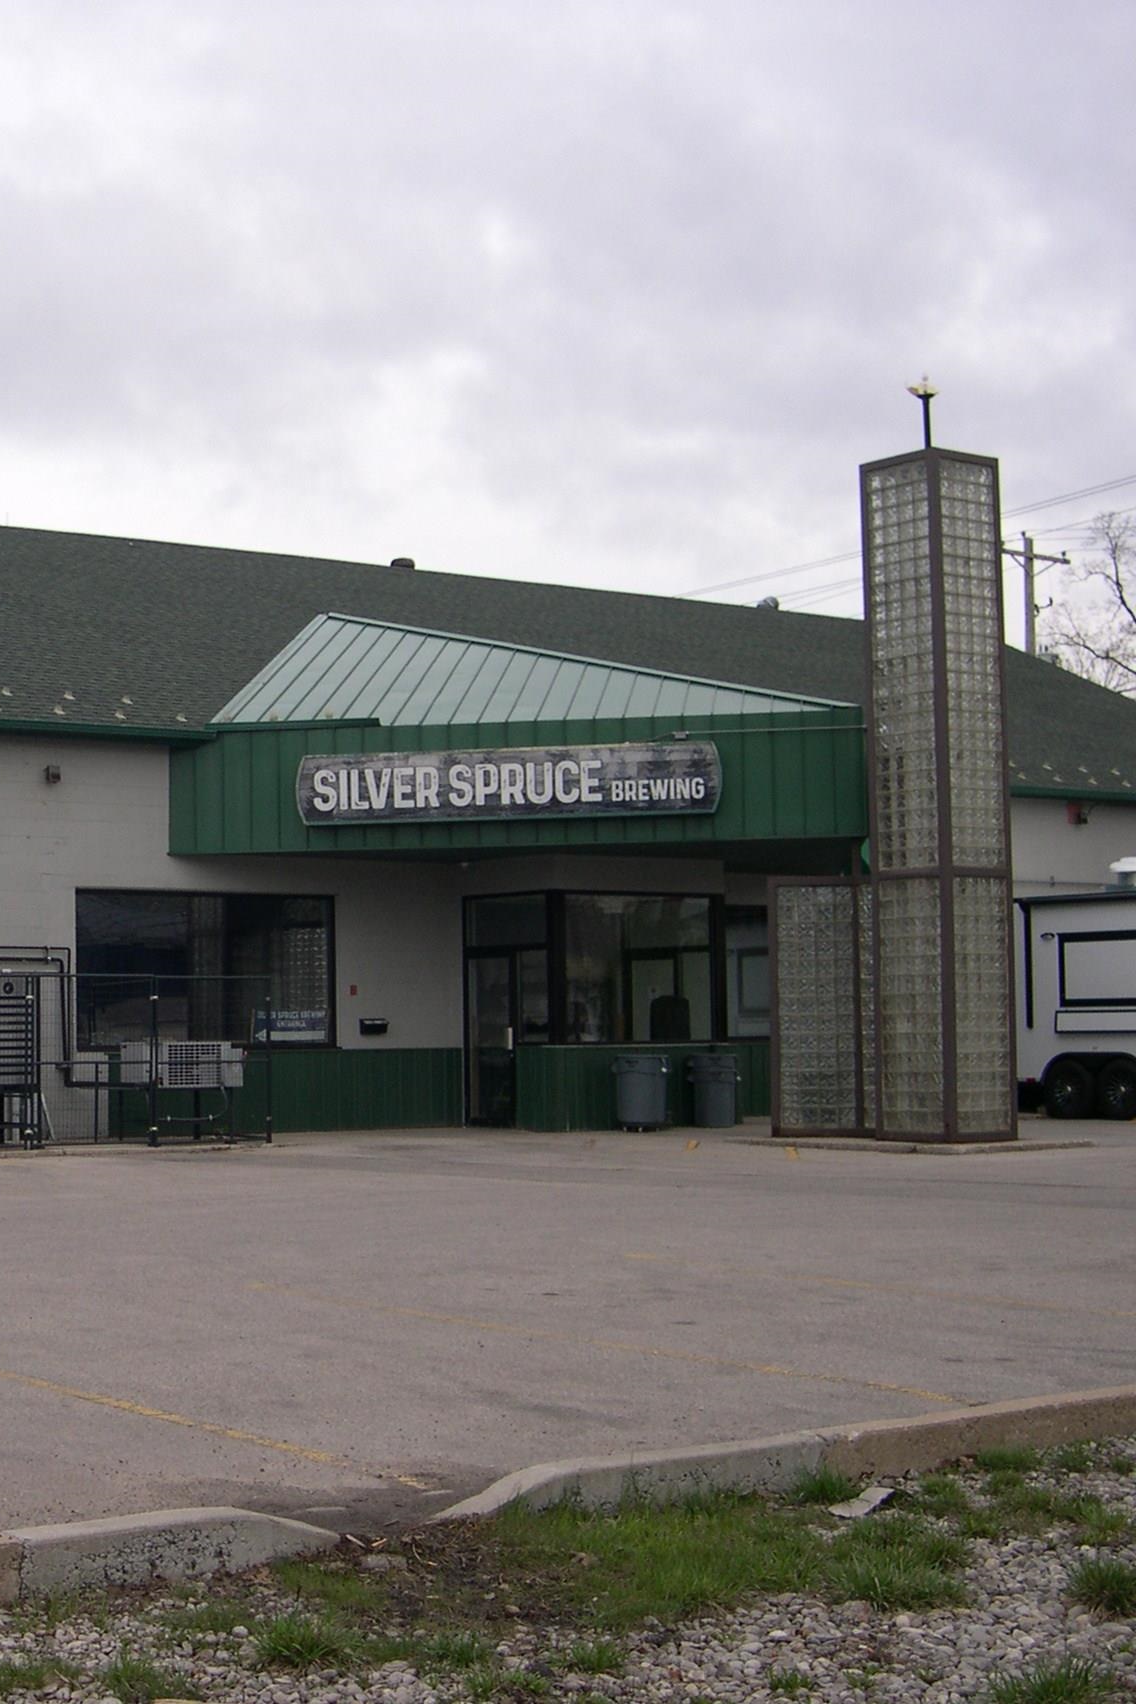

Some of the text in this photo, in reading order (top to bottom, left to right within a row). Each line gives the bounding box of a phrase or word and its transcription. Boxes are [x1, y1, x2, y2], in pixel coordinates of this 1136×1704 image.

[313, 760, 705, 812] SILVER SPRUCE BREWING
